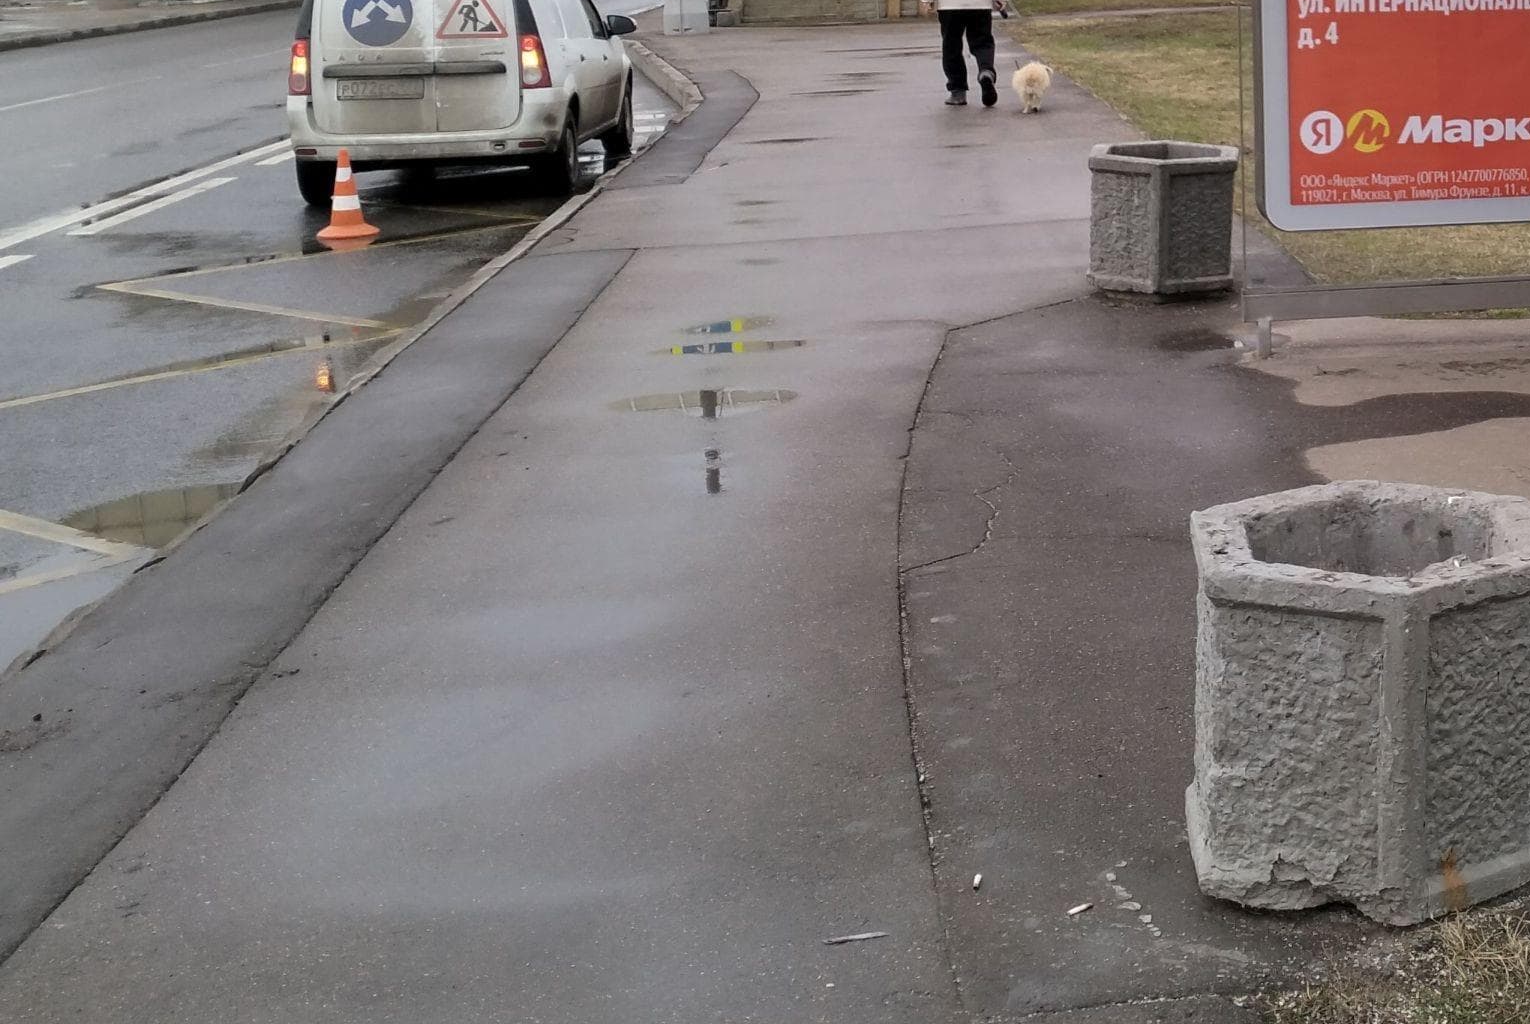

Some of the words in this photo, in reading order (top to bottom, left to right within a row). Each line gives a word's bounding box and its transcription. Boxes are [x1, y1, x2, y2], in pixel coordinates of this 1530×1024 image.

[1297, 27, 1321, 49] д.
[1324, 22, 1340, 45] 4
[1300, 174, 1326, 188] ООО
[1417, 170, 1449, 185] (ОГРН
[1301, 189, 1341, 203] 119021,
[1410, 186, 1449, 200] Тимура
